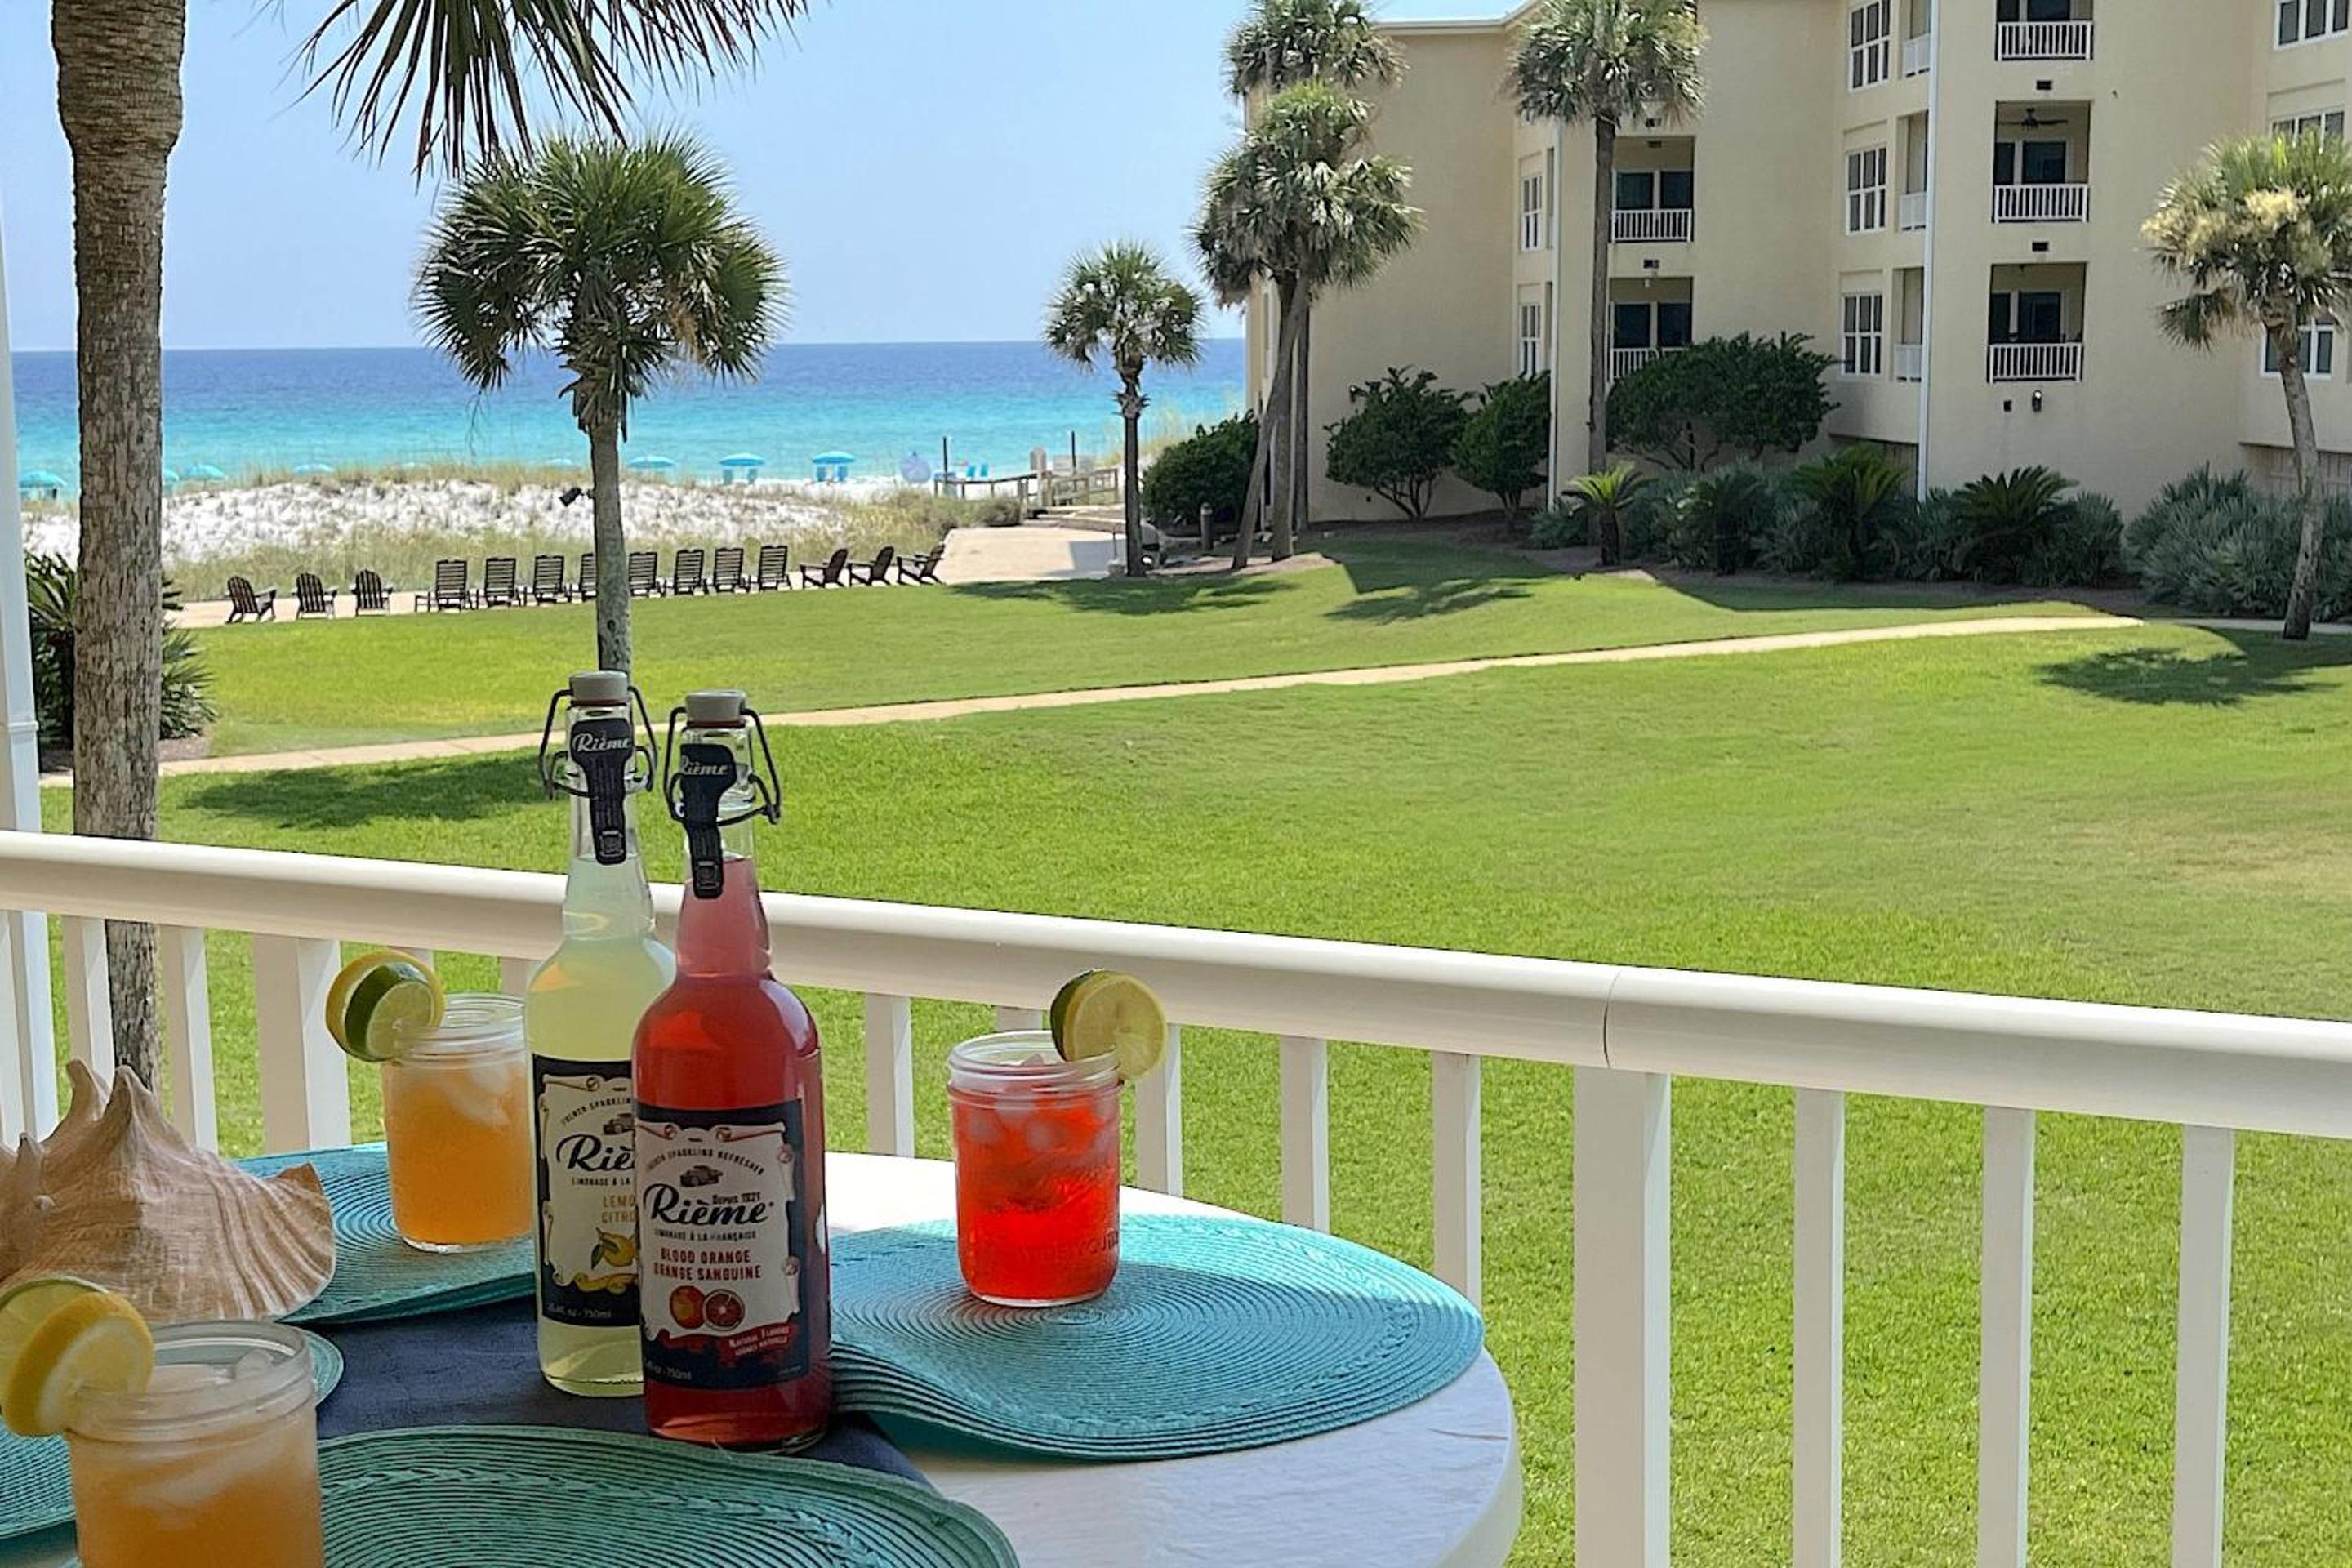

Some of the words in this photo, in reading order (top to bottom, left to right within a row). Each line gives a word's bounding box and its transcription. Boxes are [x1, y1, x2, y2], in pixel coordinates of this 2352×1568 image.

[573, 733, 632, 752] Rième
[556, 1133, 635, 1173] Riè
[603, 1194, 636, 1209] LEMO
[642, 1183, 768, 1226] Rième
[601, 1210, 637, 1224] CITRO
[660, 1246, 696, 1264] BLOOD
[700, 1249, 751, 1266] ORANGE
[654, 1261, 694, 1281] ORANGE
[697, 1264, 762, 1282] SANGUINE
